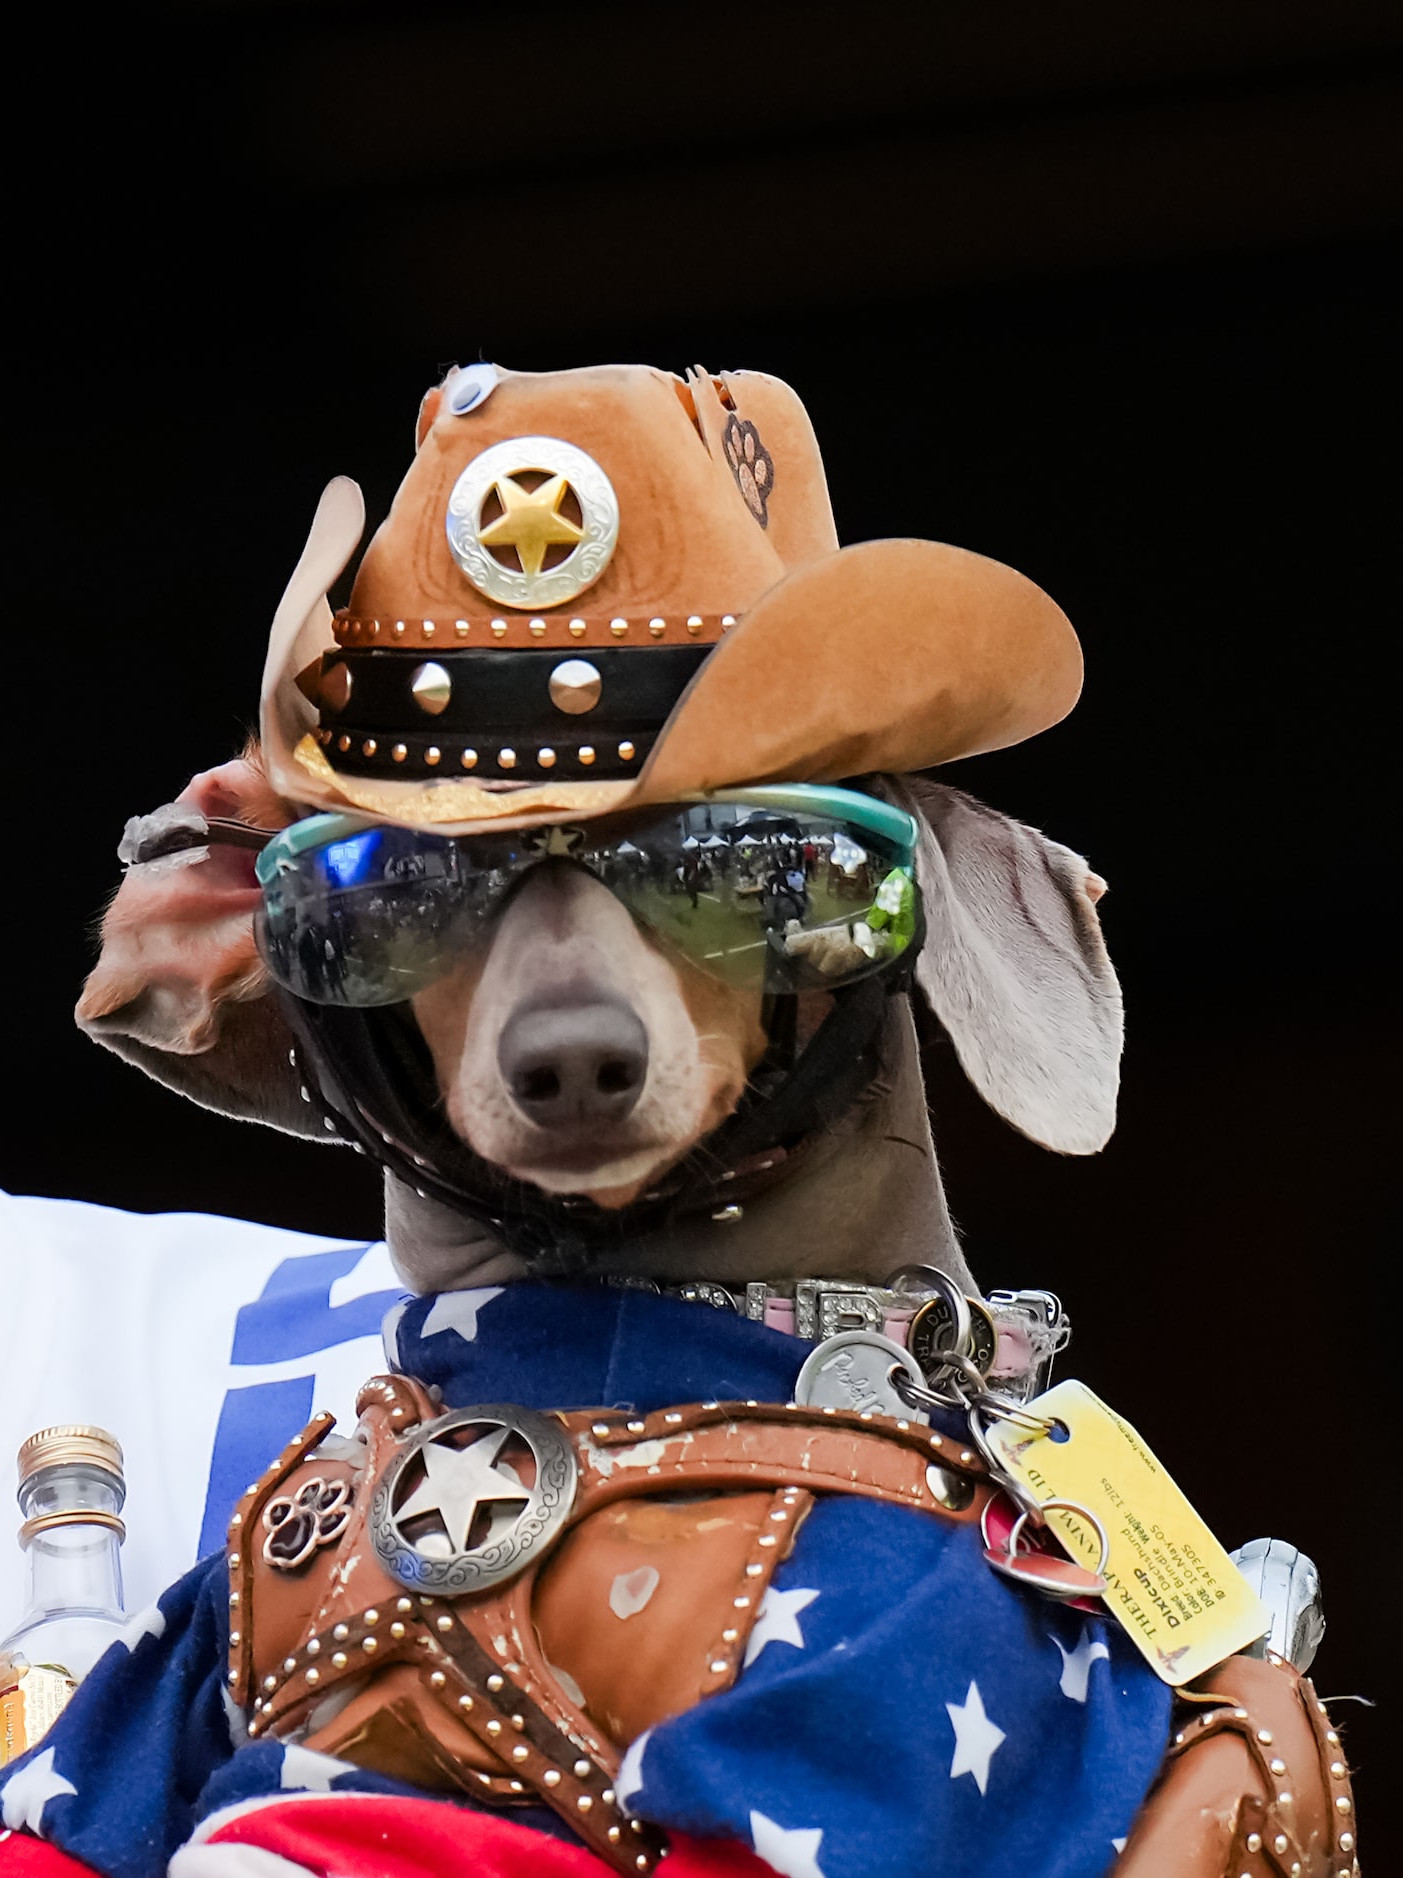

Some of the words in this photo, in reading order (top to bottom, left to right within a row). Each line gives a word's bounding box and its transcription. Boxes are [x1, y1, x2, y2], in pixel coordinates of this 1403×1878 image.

[1026, 1468, 1046, 1488] ID
[1099, 1476, 1125, 1508] 12lbs
[1119, 1527, 1171, 1591] Dachshund
[1148, 1523, 1198, 1585] 10-May-05
[1151, 1547, 1184, 1589] Brindle
[1180, 1543, 1217, 1586] 347305
